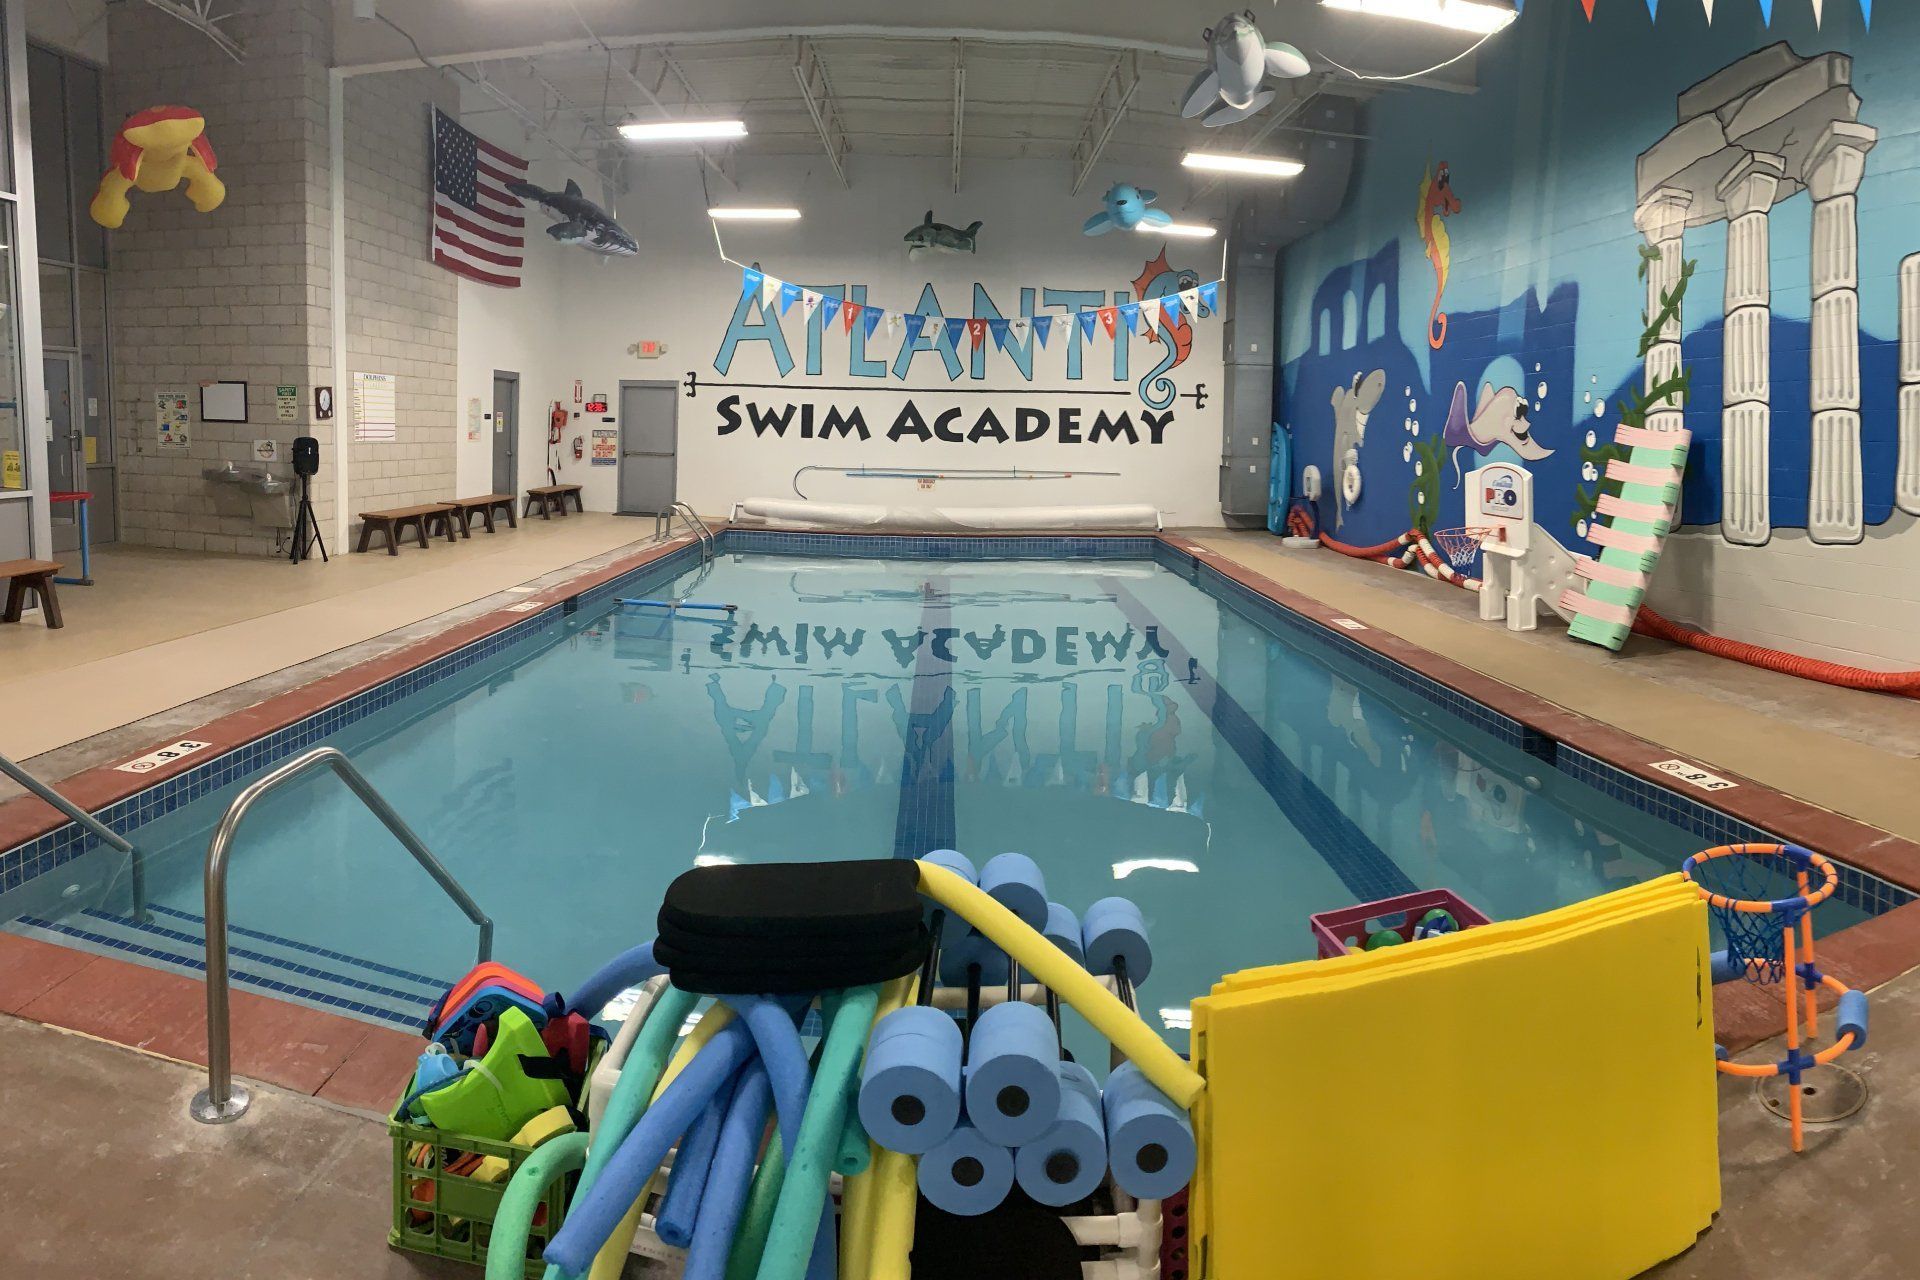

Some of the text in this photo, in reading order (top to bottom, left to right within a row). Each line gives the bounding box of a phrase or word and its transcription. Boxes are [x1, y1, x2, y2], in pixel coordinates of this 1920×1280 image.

[1102, 312, 1113, 325] 3
[973, 323, 981, 336] 2
[716, 394, 1175, 446] SWIM ACADEMY
[1486, 487, 1517, 506] PRO
